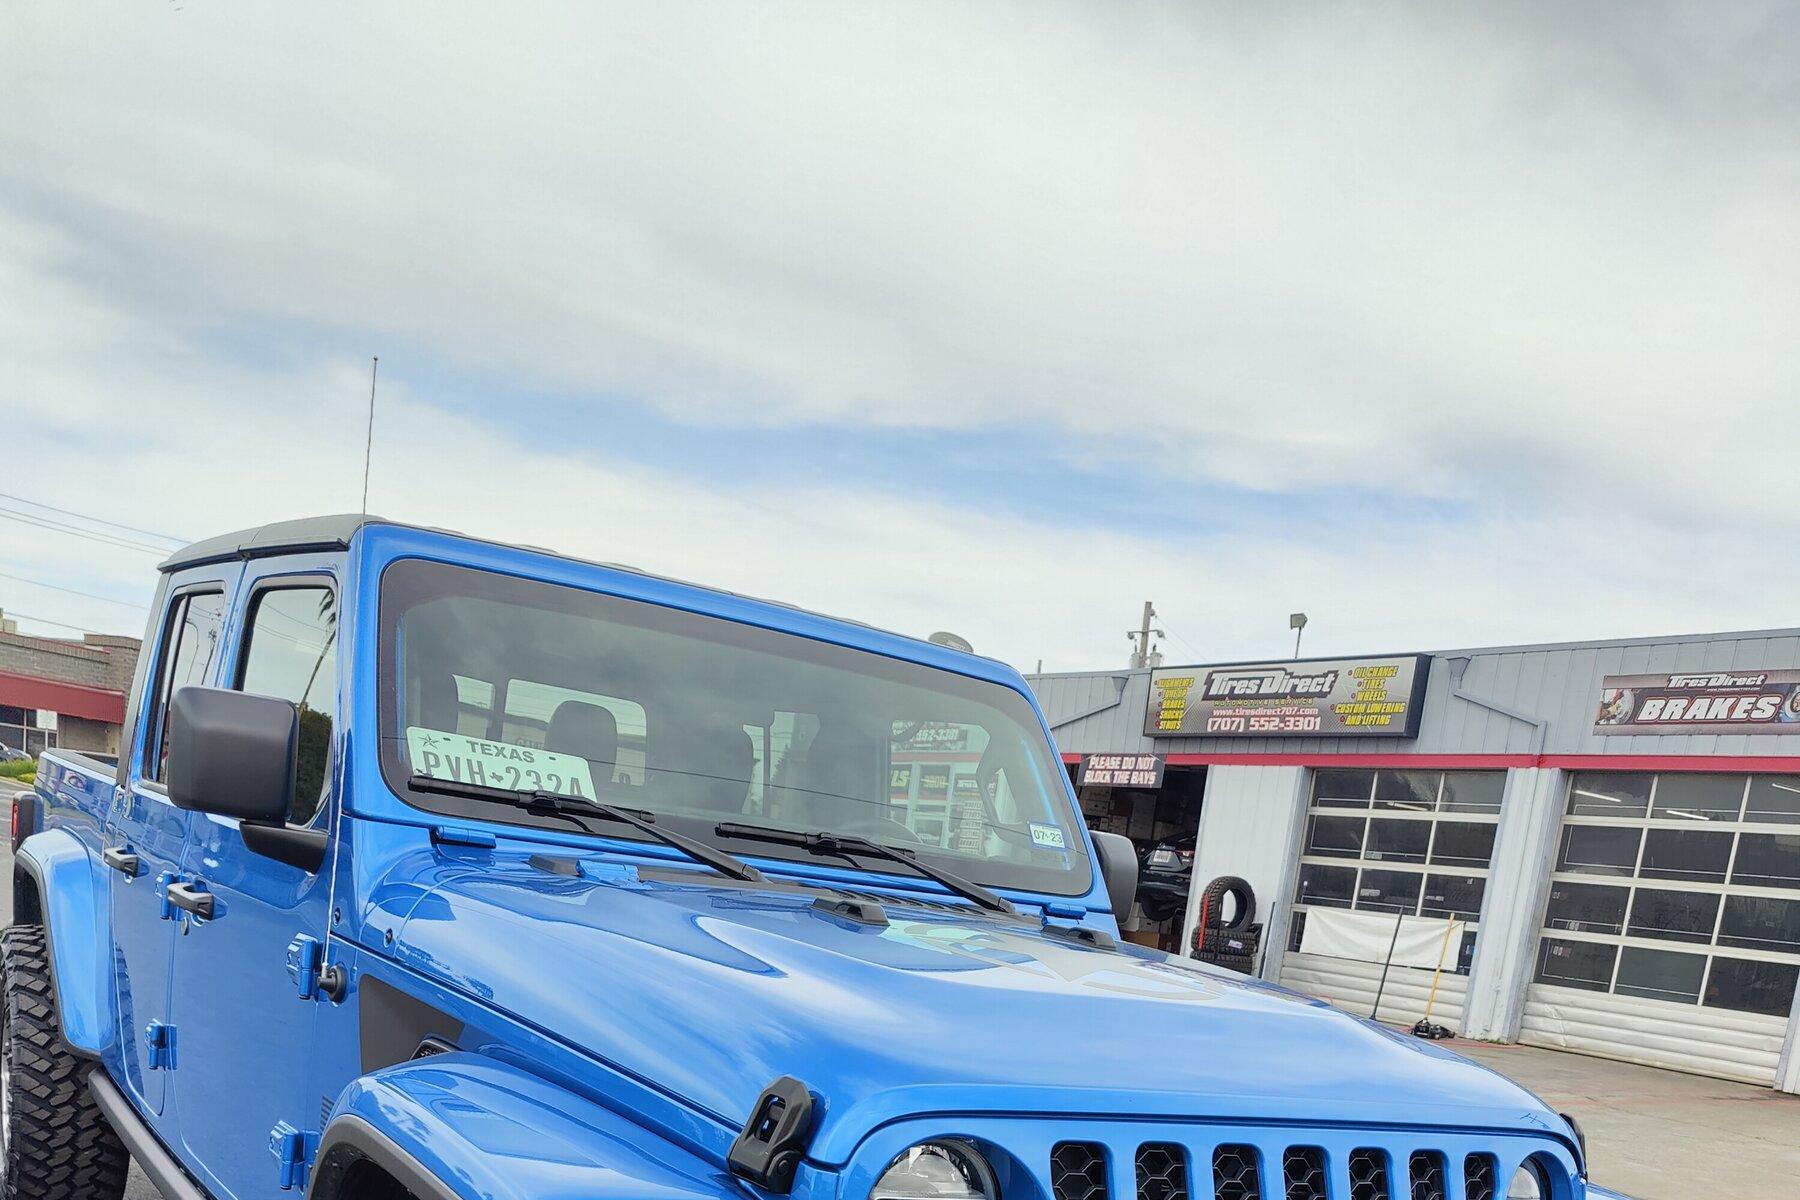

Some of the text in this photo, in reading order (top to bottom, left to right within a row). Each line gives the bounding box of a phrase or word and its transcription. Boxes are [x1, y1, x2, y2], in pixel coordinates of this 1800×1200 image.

[1354, 665, 1399, 678] OIL CHANGE
[1361, 679, 1386, 690] TIRES
[1356, 690, 1387, 701] WHEELS
[1212, 706, 1319, 717] www.tiresdirect707.com
[1334, 702, 1407, 714] CUSTOM LOWERING
[1637, 696, 1782, 722] BRAKES
[1207, 715, 1322, 733] (707) 552-3301
[1345, 714, 1392, 726] AND LIFTING
[466, 739, 536, 763] TEXAS
[1088, 756, 1156, 770] PLEASE DO NOT
[1083, 770, 1157, 785] BLOCK THE BAYS
